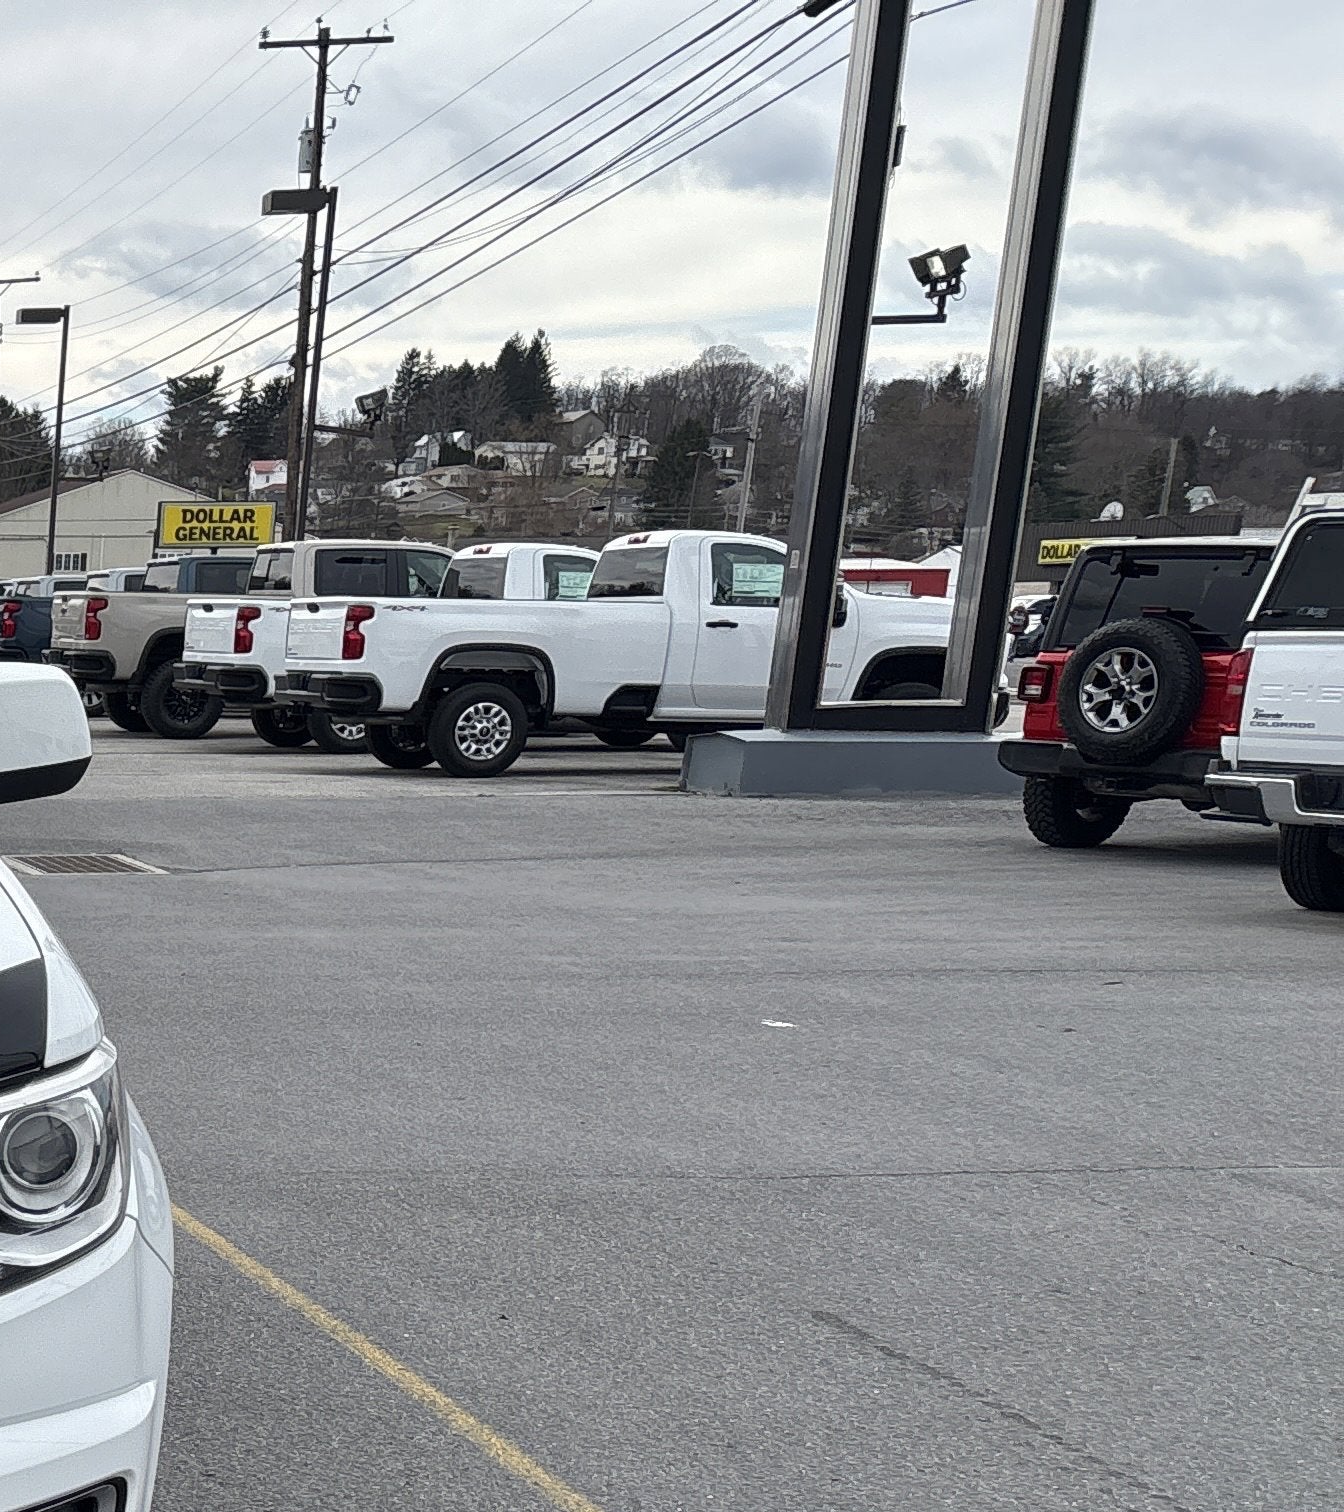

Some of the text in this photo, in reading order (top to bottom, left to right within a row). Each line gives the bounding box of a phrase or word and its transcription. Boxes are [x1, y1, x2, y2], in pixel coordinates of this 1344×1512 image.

[180, 508, 256, 524] DOLLAR
[174, 525, 260, 542] GENERAL
[1249, 720, 1316, 729] COLORADO
